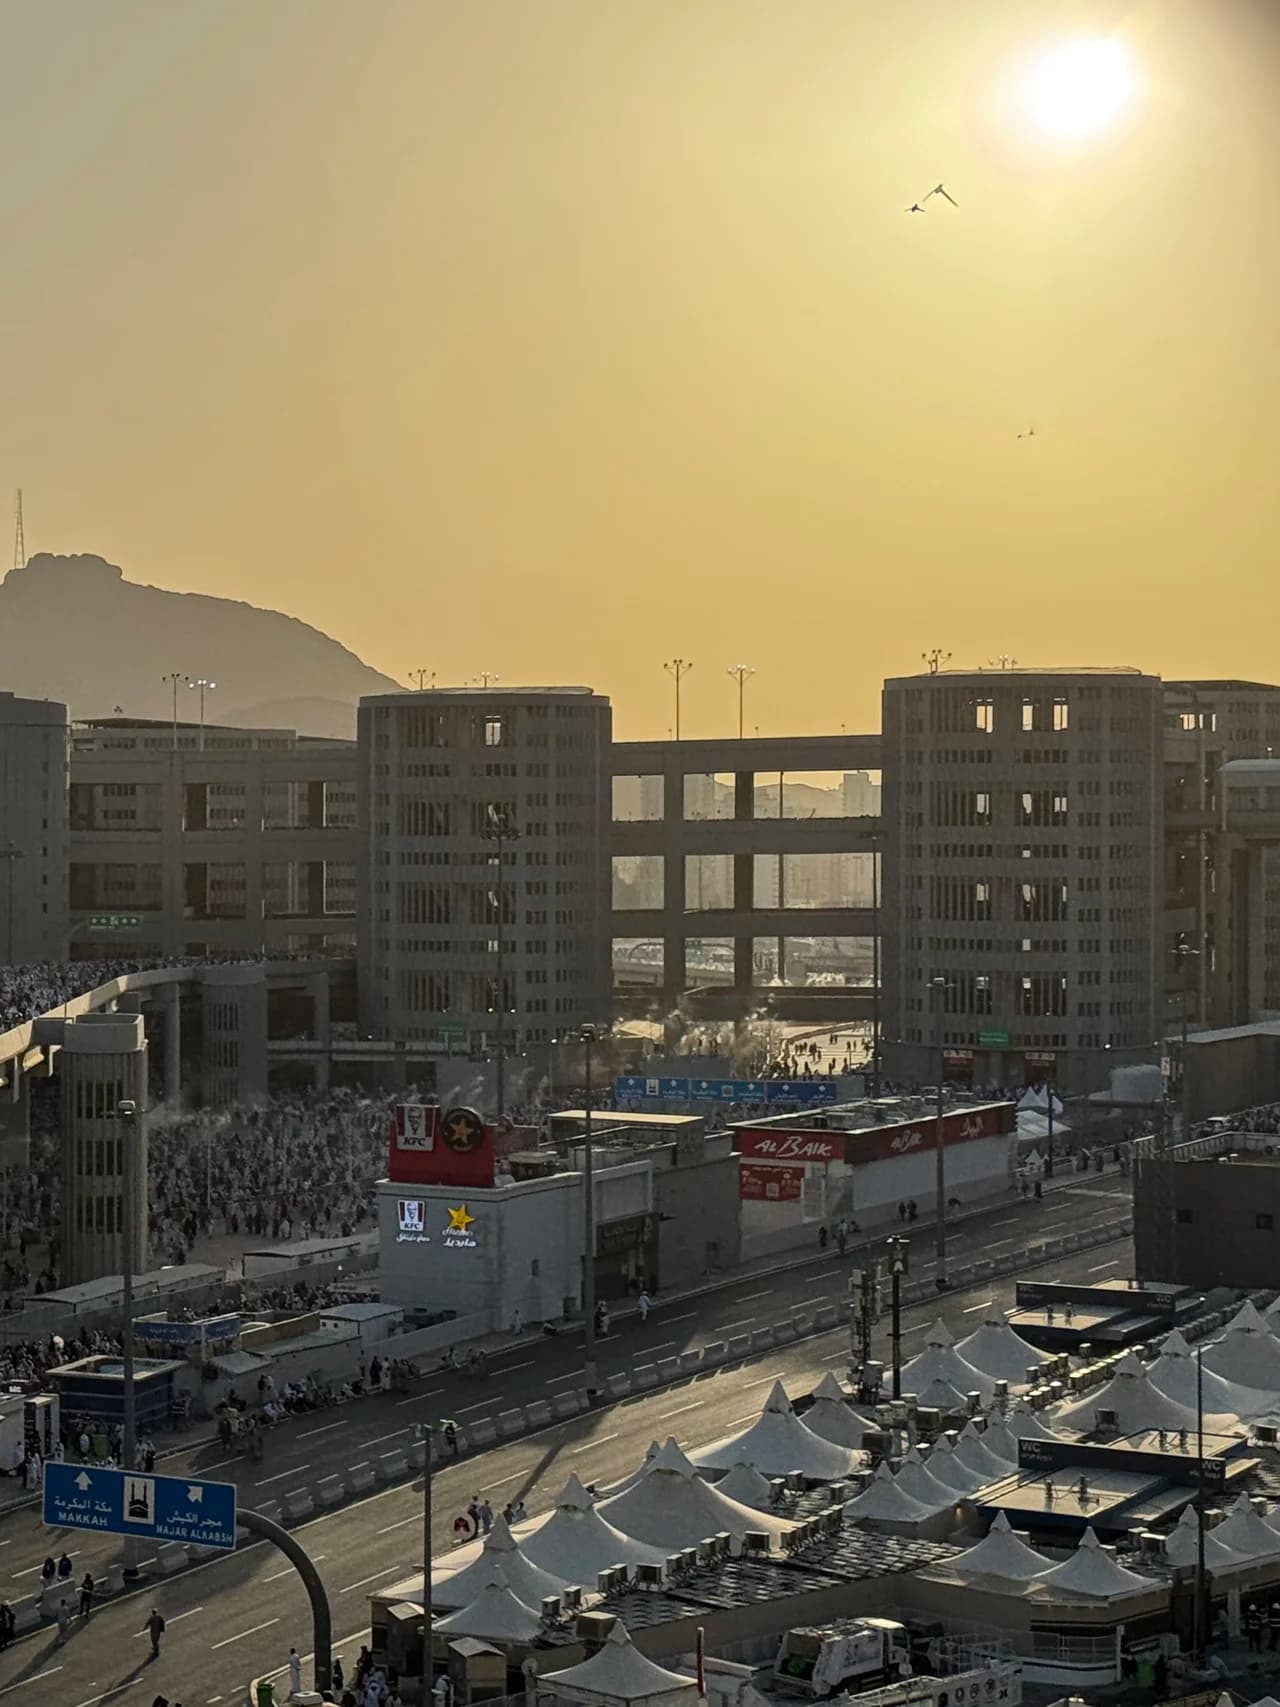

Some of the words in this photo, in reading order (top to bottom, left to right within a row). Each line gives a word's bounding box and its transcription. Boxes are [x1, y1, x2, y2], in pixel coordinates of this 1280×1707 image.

[404, 1137, 426, 1146] KFC
[1021, 1441, 1041, 1452] WC
[1201, 1460, 1222, 1471] WC
[53, 1495, 91, 1510] المكرمة
[94, 1500, 113, 1513] مكة
[58, 1511, 108, 1527] MAKKAH
[166, 1509, 198, 1525] الكبش
[200, 1518, 223, 1528] مجر
[155, 1524, 188, 1537] MAJAR
[190, 1528, 233, 1544] ALKABSH
